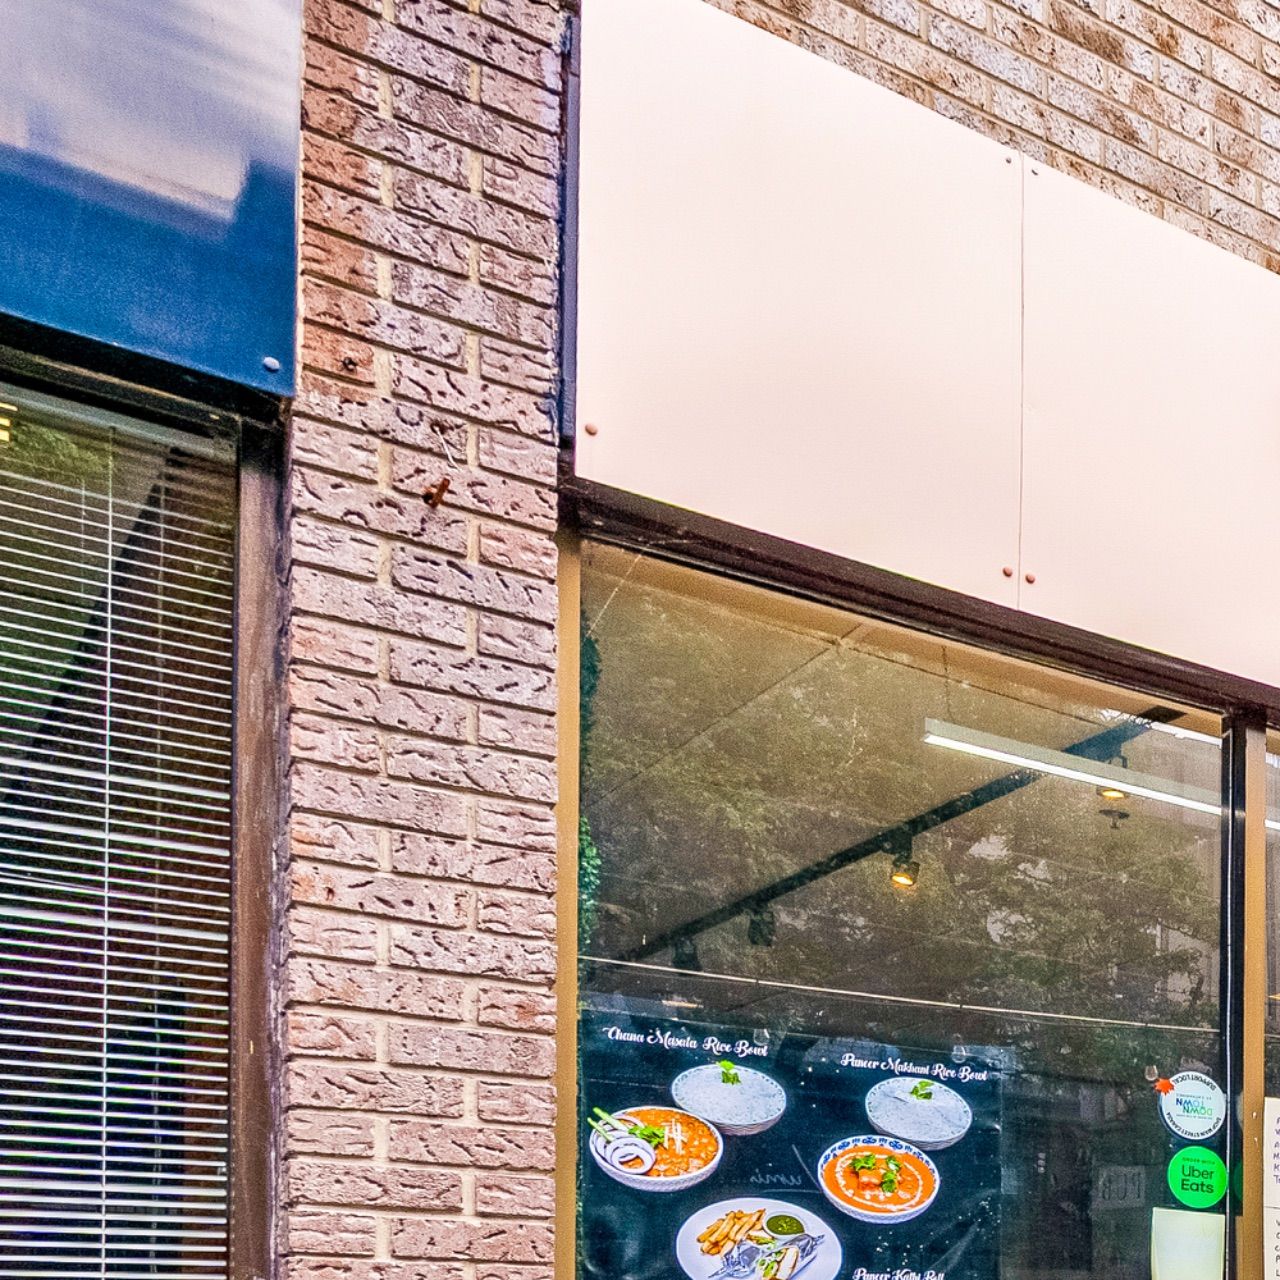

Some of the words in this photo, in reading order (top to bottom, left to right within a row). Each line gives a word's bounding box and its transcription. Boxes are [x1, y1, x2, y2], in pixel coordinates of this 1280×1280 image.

[602, 1026, 644, 1043] Chana
[646, 1027, 698, 1050] Masala
[702, 1036, 732, 1056] Rice
[735, 1039, 769, 1058] Bowl
[840, 1052, 879, 1069] Paneer
[931, 1063, 957, 1081] Rice
[958, 1066, 988, 1083] Bowl
[1181, 1164, 1215, 1180] Uber
[1180, 1179, 1215, 1194] Eats
